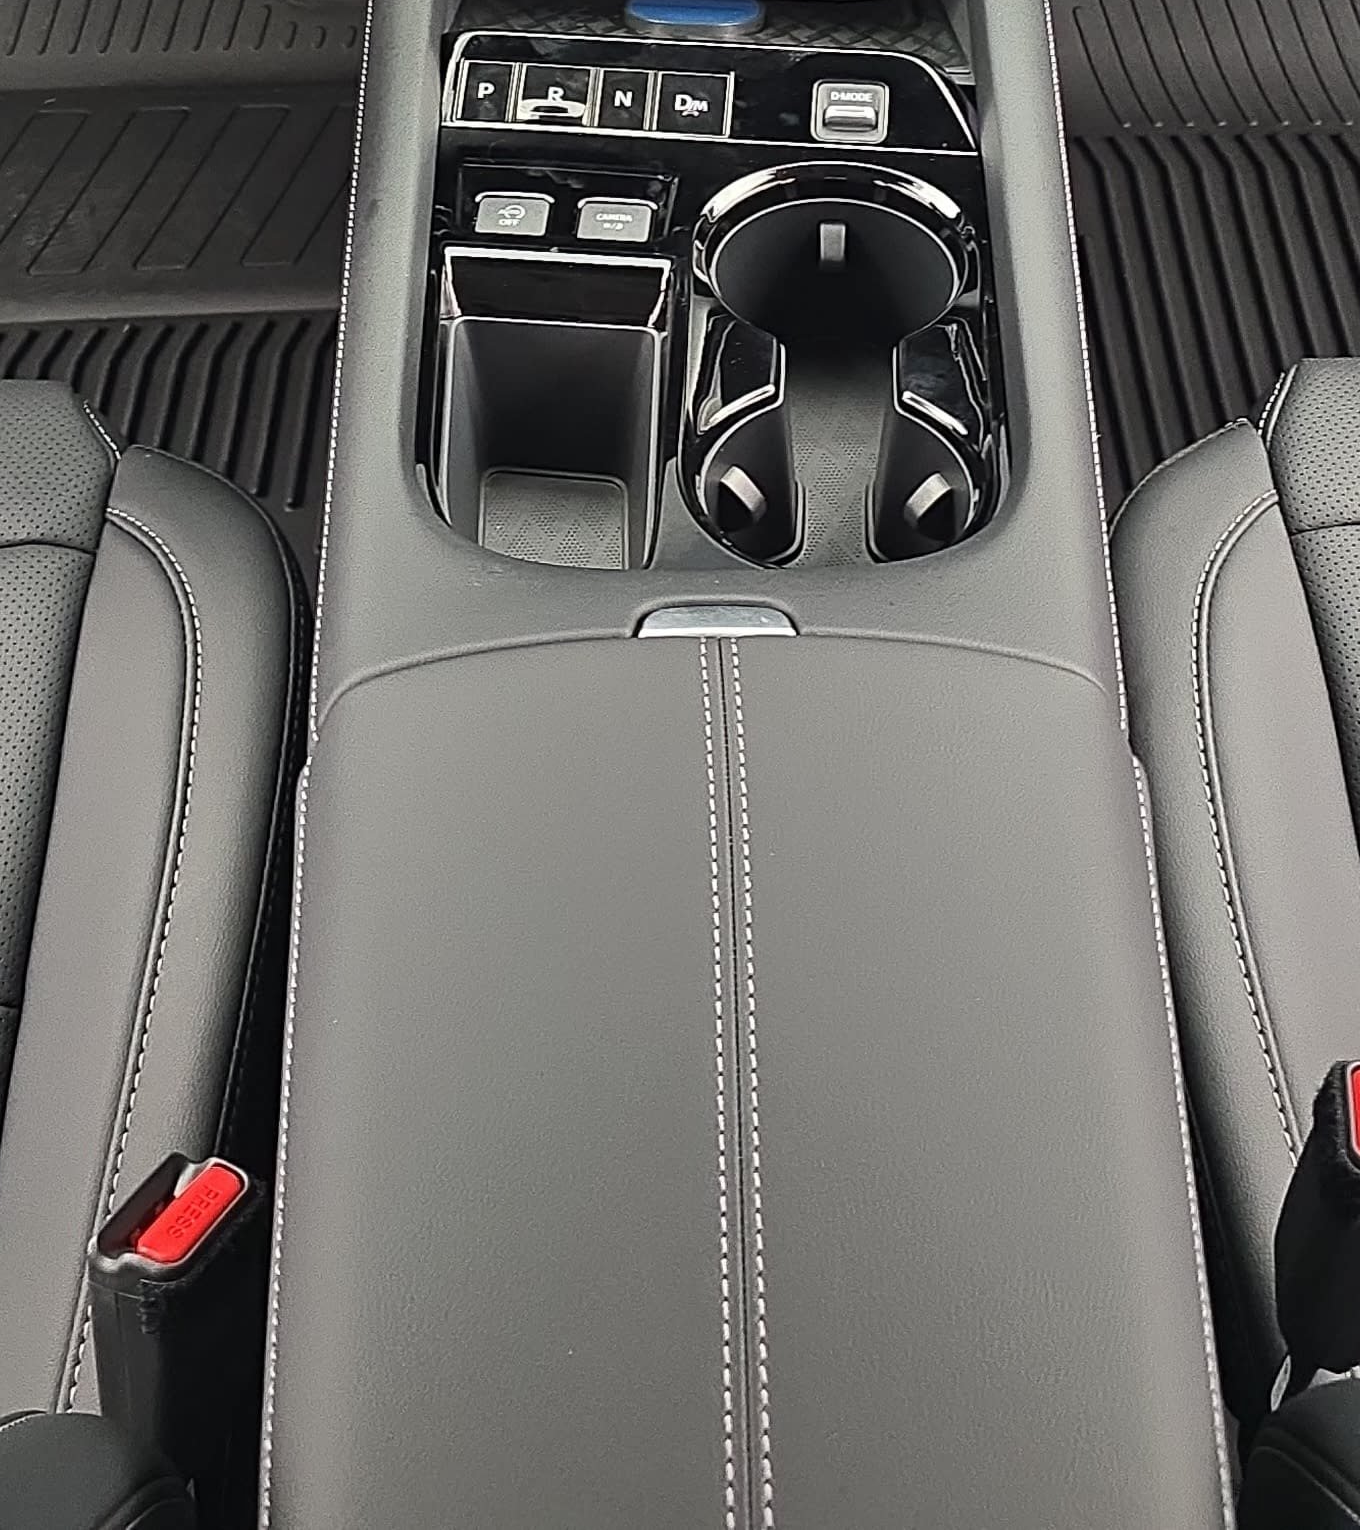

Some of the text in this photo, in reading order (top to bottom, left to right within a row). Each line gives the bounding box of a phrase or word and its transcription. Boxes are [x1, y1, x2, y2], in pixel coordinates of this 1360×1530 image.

[478, 82, 495, 98] P
[547, 86, 565, 102] R
[614, 90, 633, 107] N
[595, 213, 633, 222] CAMERA
[166, 1184, 223, 1239] PRESS
